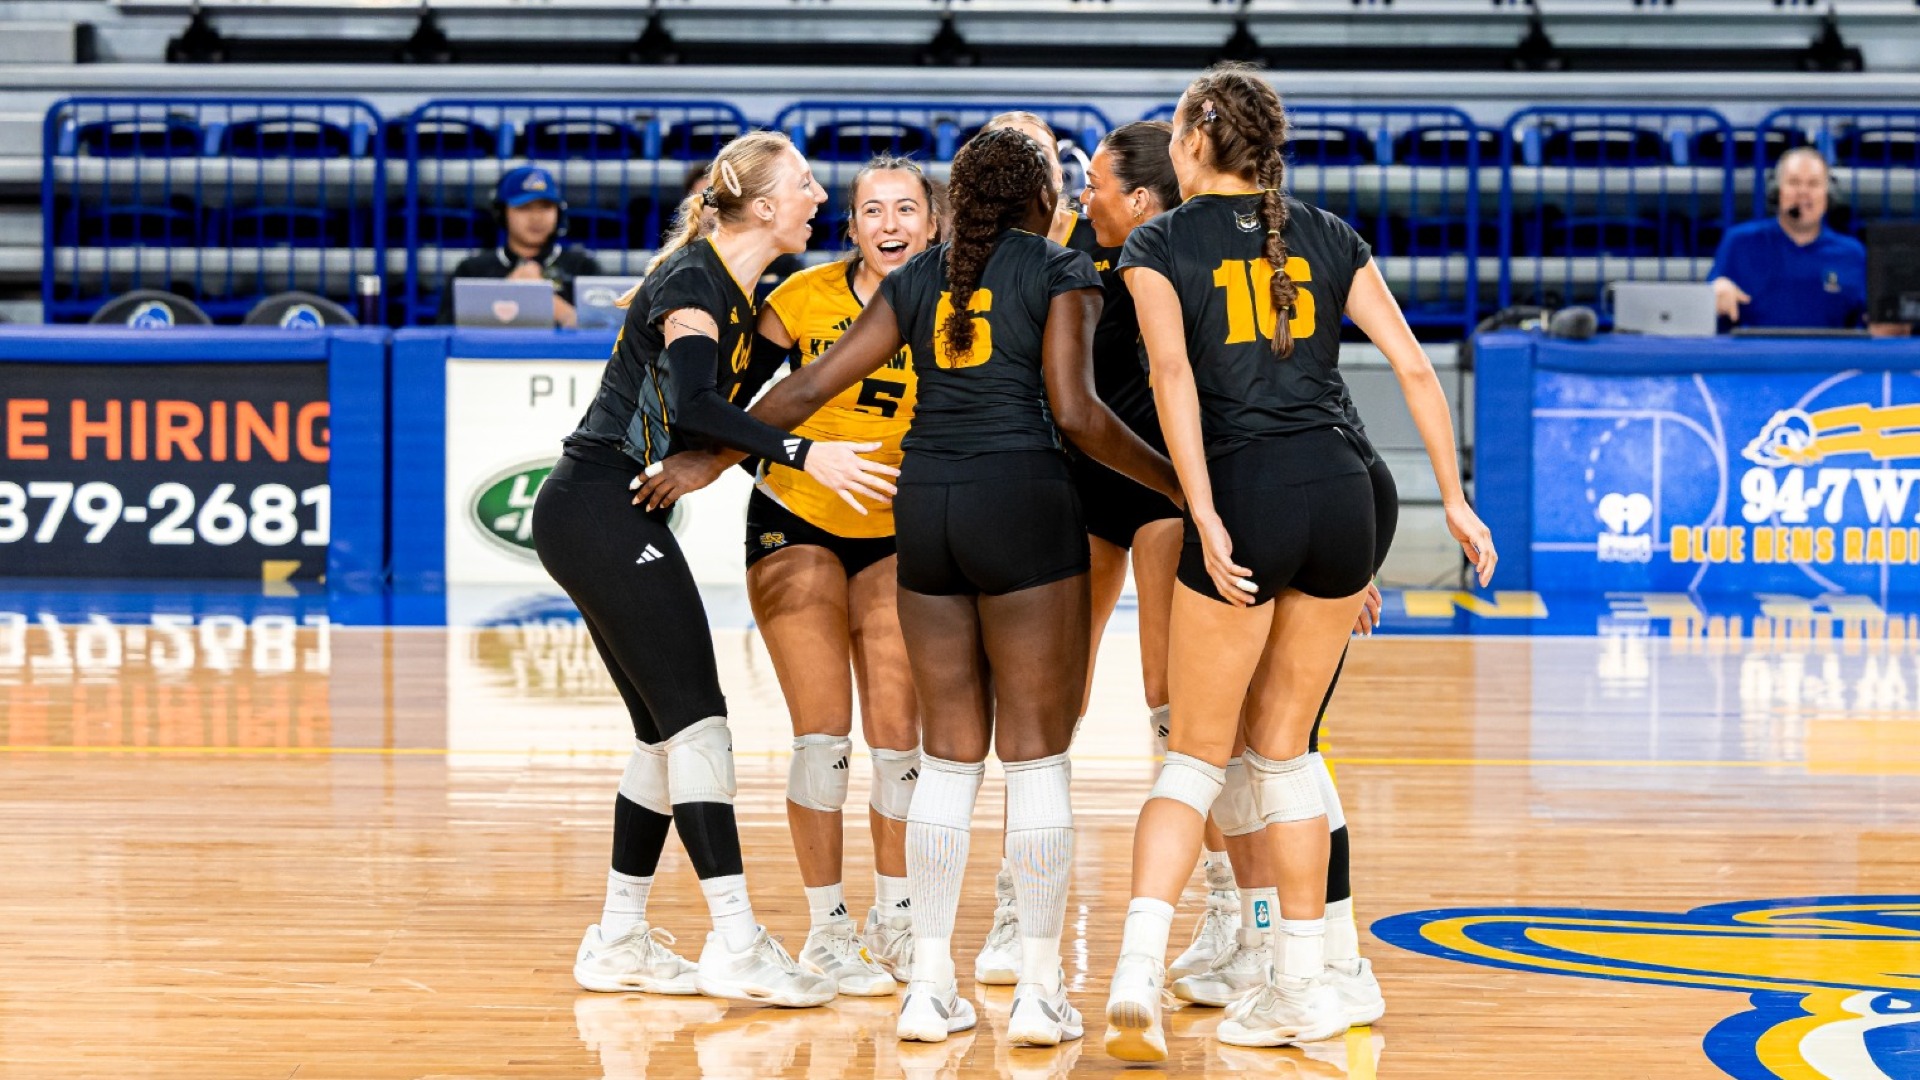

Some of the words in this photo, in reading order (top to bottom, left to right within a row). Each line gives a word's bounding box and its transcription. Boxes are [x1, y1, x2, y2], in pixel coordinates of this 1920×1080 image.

[1212, 256, 1316, 344] 16
[934, 287, 993, 369] 6
[529, 375, 577, 407] PI
[854, 377, 907, 418] 5
[0, 399, 49, 460] E
[70, 399, 331, 462] HIRING
[1669, 525, 1746, 563] BLUE
[1753, 526, 1835, 564] HENS
[1843, 527, 1920, 564] RADI
